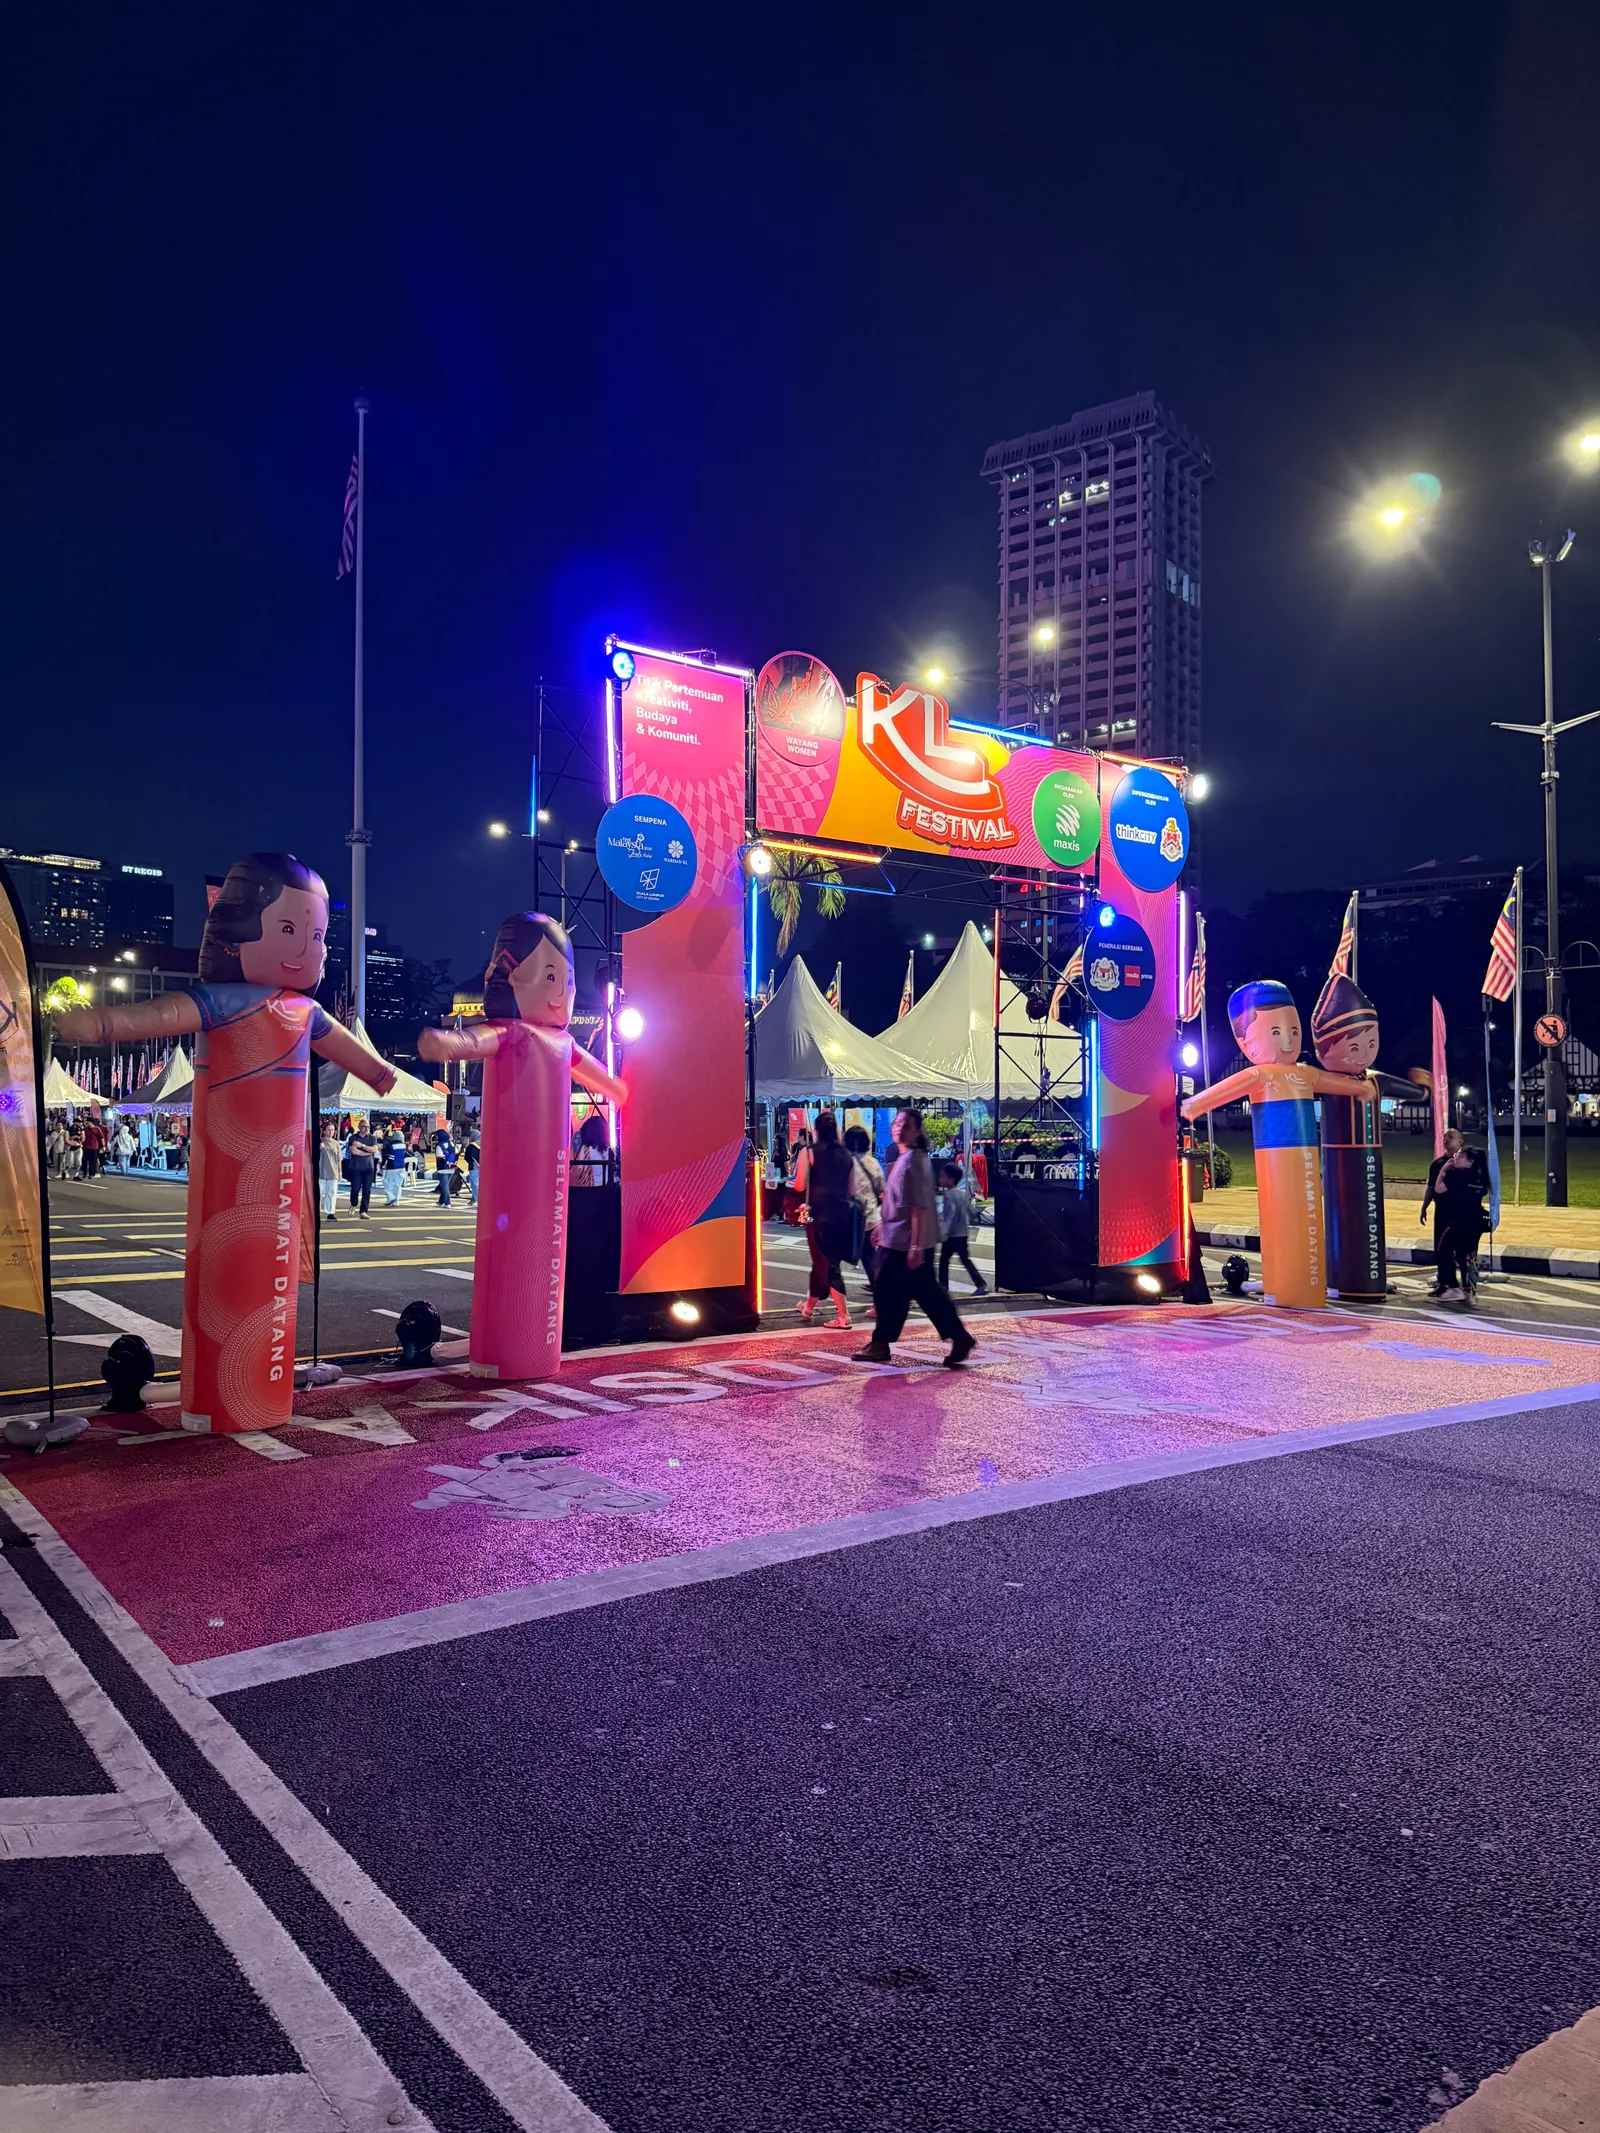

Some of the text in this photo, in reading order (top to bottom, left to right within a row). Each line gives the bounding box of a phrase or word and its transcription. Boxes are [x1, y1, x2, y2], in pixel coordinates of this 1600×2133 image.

[636, 690, 693, 714] Kreativiti,
[664, 680, 724, 703] Pertemuan
[636, 706, 678, 726] Budaya
[636, 722, 701, 746] & Komuniti.
[786, 736, 819, 750] WAYANG
[862, 679, 991, 796] KL
[787, 745, 817, 758] WOMEN
[634, 815, 668, 826] SEMPENA
[901, 798, 1015, 843] FESTIVAL
[1053, 839, 1081, 852] maxis
[134, 867, 163, 877] REGIS
[1098, 942, 1122, 950] PENERAJU
[266, 999, 301, 1022] KL
[1304, 1151, 1319, 1287] SELAMAT DATANG
[1366, 1155, 1379, 1280] SELAMAT DATANG
[546, 1149, 566, 1345] SELAMAT DATANG
[269, 1143, 295, 1382] SELAMAT DATANG
